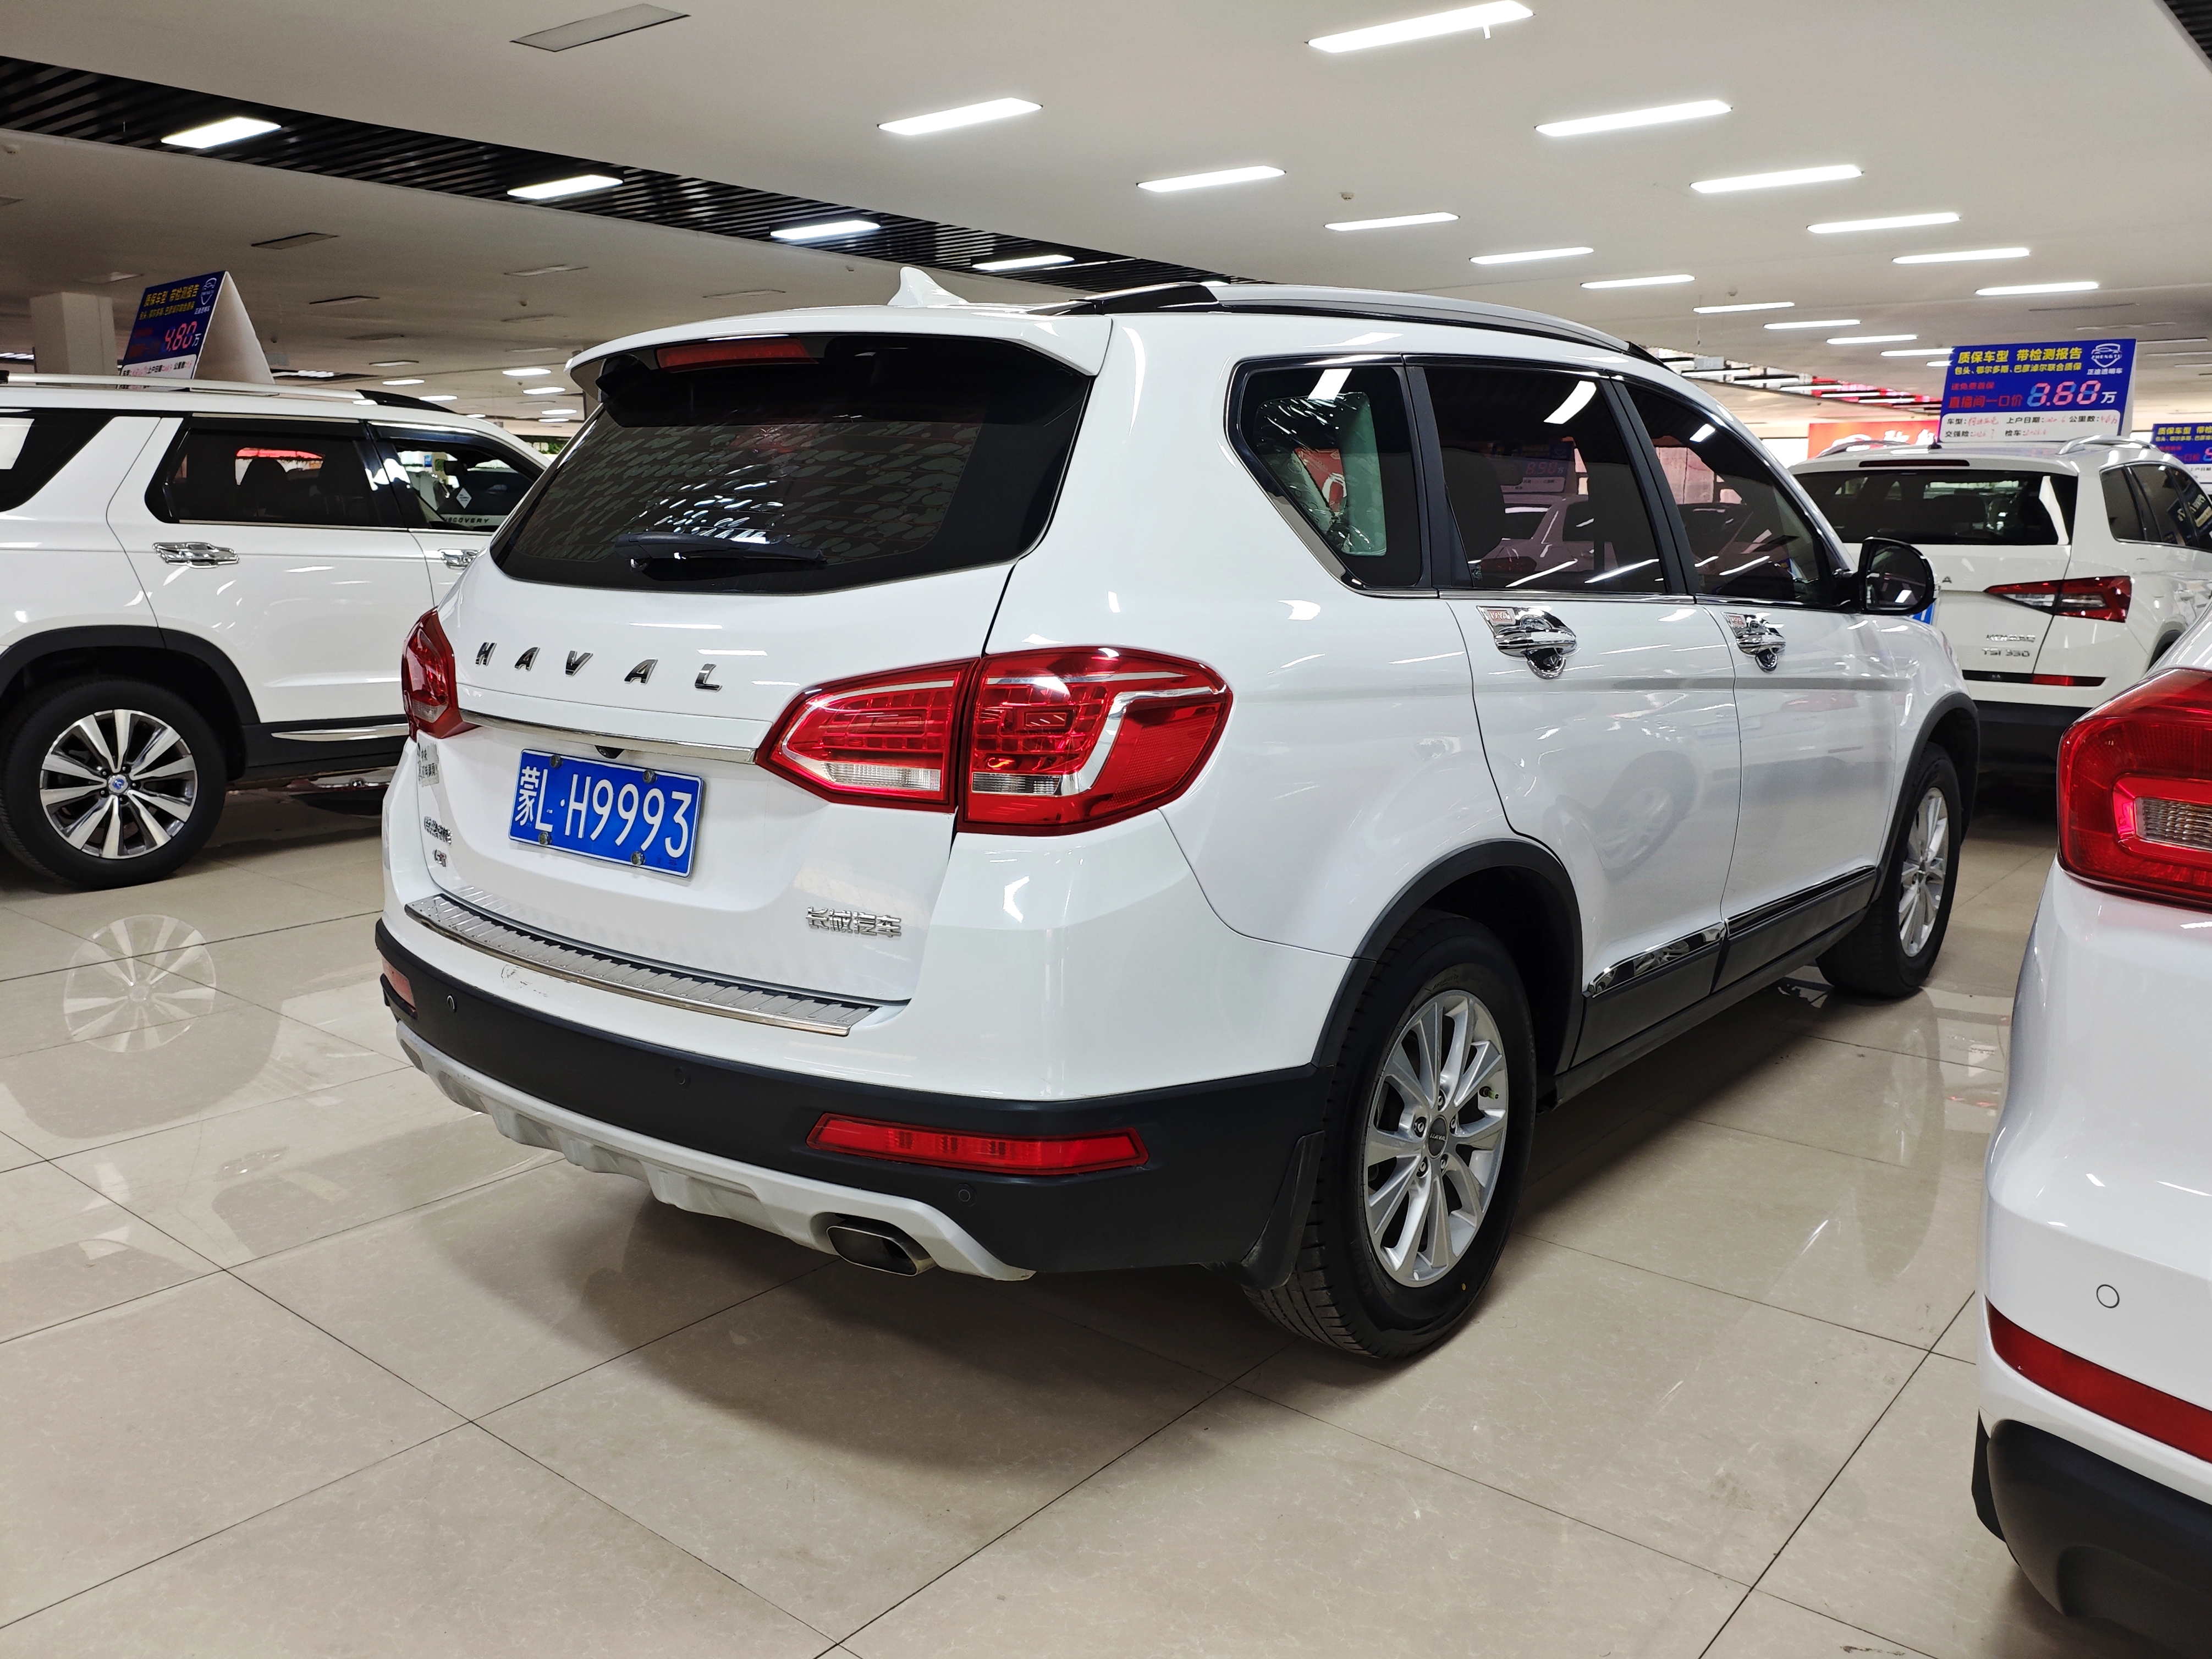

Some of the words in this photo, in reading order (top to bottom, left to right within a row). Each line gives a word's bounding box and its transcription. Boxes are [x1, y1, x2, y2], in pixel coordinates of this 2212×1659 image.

[164, 321, 197, 352] 4.80
[191, 333, 202, 347] 万
[1958, 349, 2009, 364] 质保车型
[2016, 347, 2083, 361] 带检测报告
[1948, 394, 2023, 409] 直播间一口价
[2100, 391, 2117, 404] 万
[475, 641, 723, 693] HAVAL
[1981, 647, 2002, 656] TSI
[2005, 649, 2031, 657] 330
[515, 765, 692, 858] 蒙L·H9993
[806, 906, 902, 938] 长城汽车
